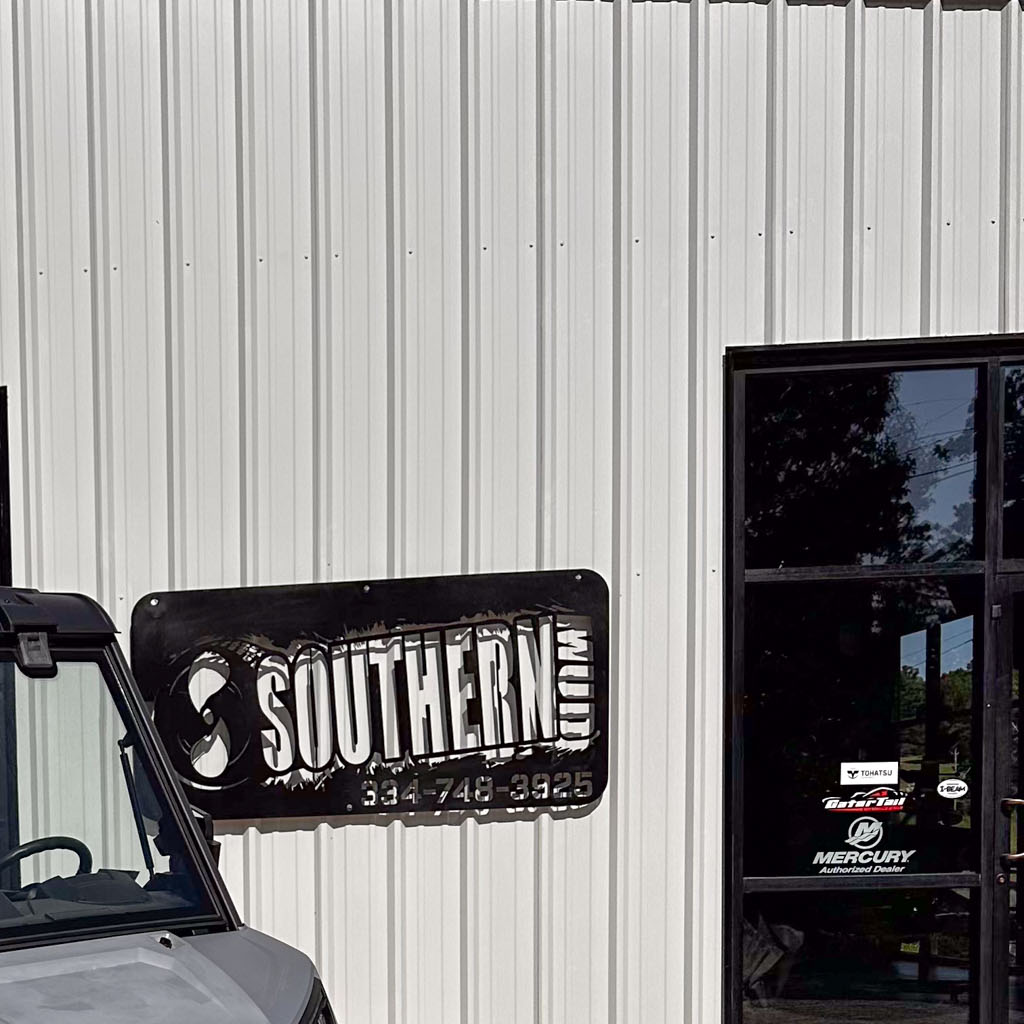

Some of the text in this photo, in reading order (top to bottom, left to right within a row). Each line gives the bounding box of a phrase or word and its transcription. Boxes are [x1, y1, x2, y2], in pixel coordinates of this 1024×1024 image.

[556, 615, 595, 742] MUD
[257, 616, 556, 772] SOUTHERN
[861, 769, 893, 777] TOHATSU
[360, 771, 593, 807] 334-748-3925
[812, 850, 917, 865] MERCURY
[819, 865, 905, 874] Authorized Dealer
